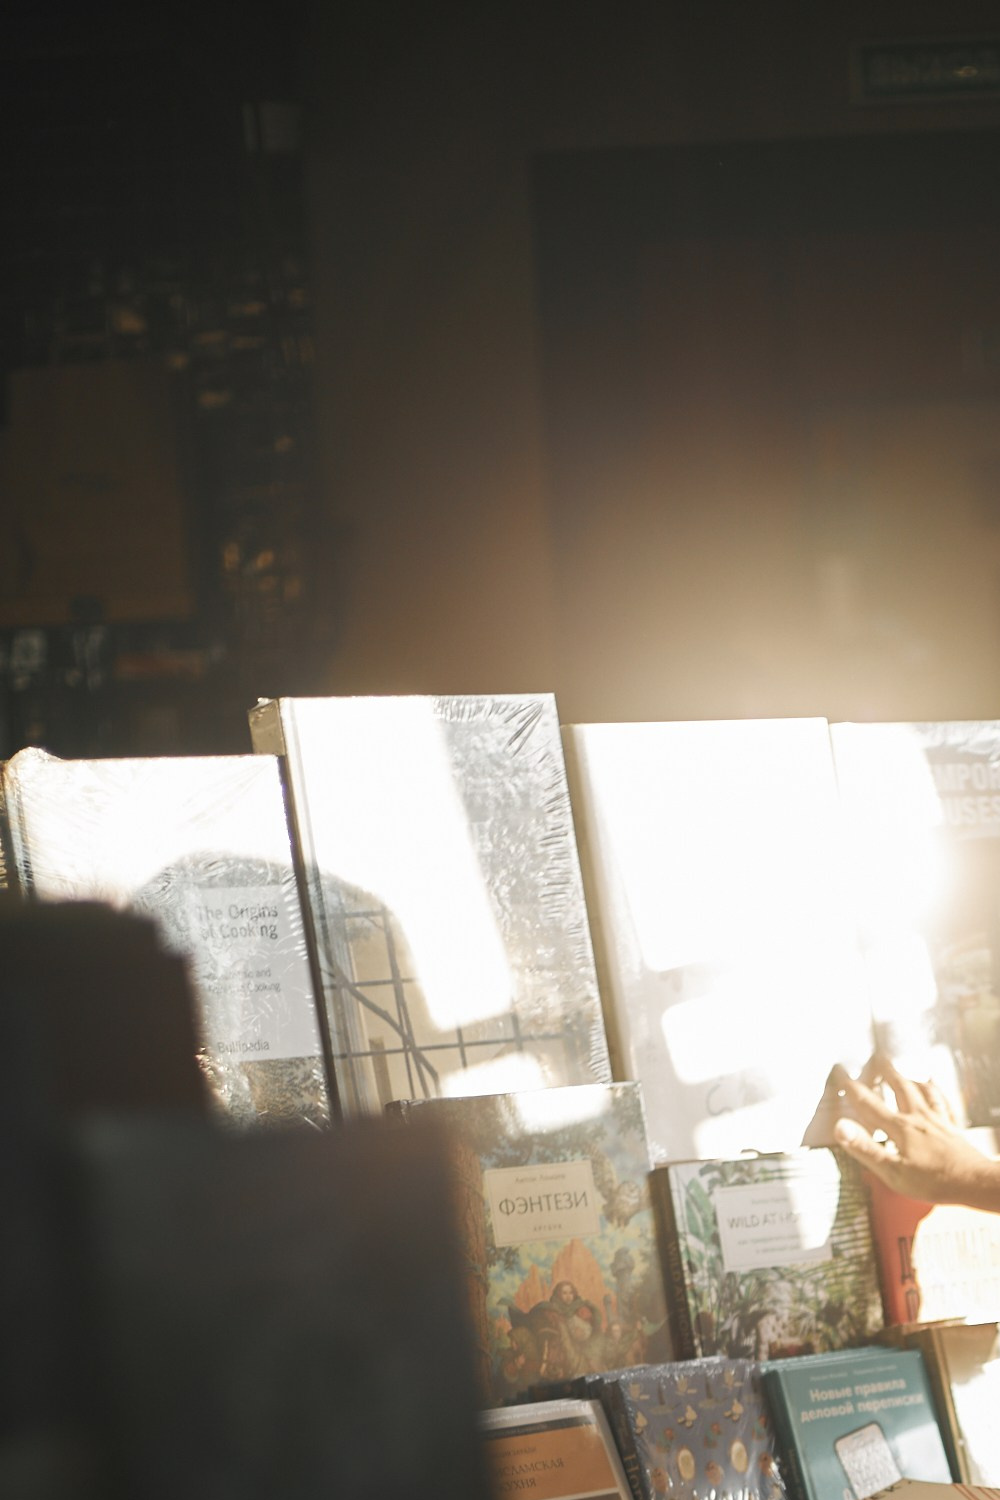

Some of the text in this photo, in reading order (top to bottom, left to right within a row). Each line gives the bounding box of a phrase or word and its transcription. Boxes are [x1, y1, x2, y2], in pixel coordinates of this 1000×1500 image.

[228, 903, 279, 921] Origins
[219, 923, 279, 940] Cooking
[217, 1040, 270, 1055] Bullipedia
[498, 1190, 589, 1216] ФЭНТЕЗИ
[727, 1213, 760, 1229] WILD
[762, 1211, 777, 1226] AT
[809, 1378, 907, 1403] Новые правила
[800, 1392, 924, 1423] деловой переписки
